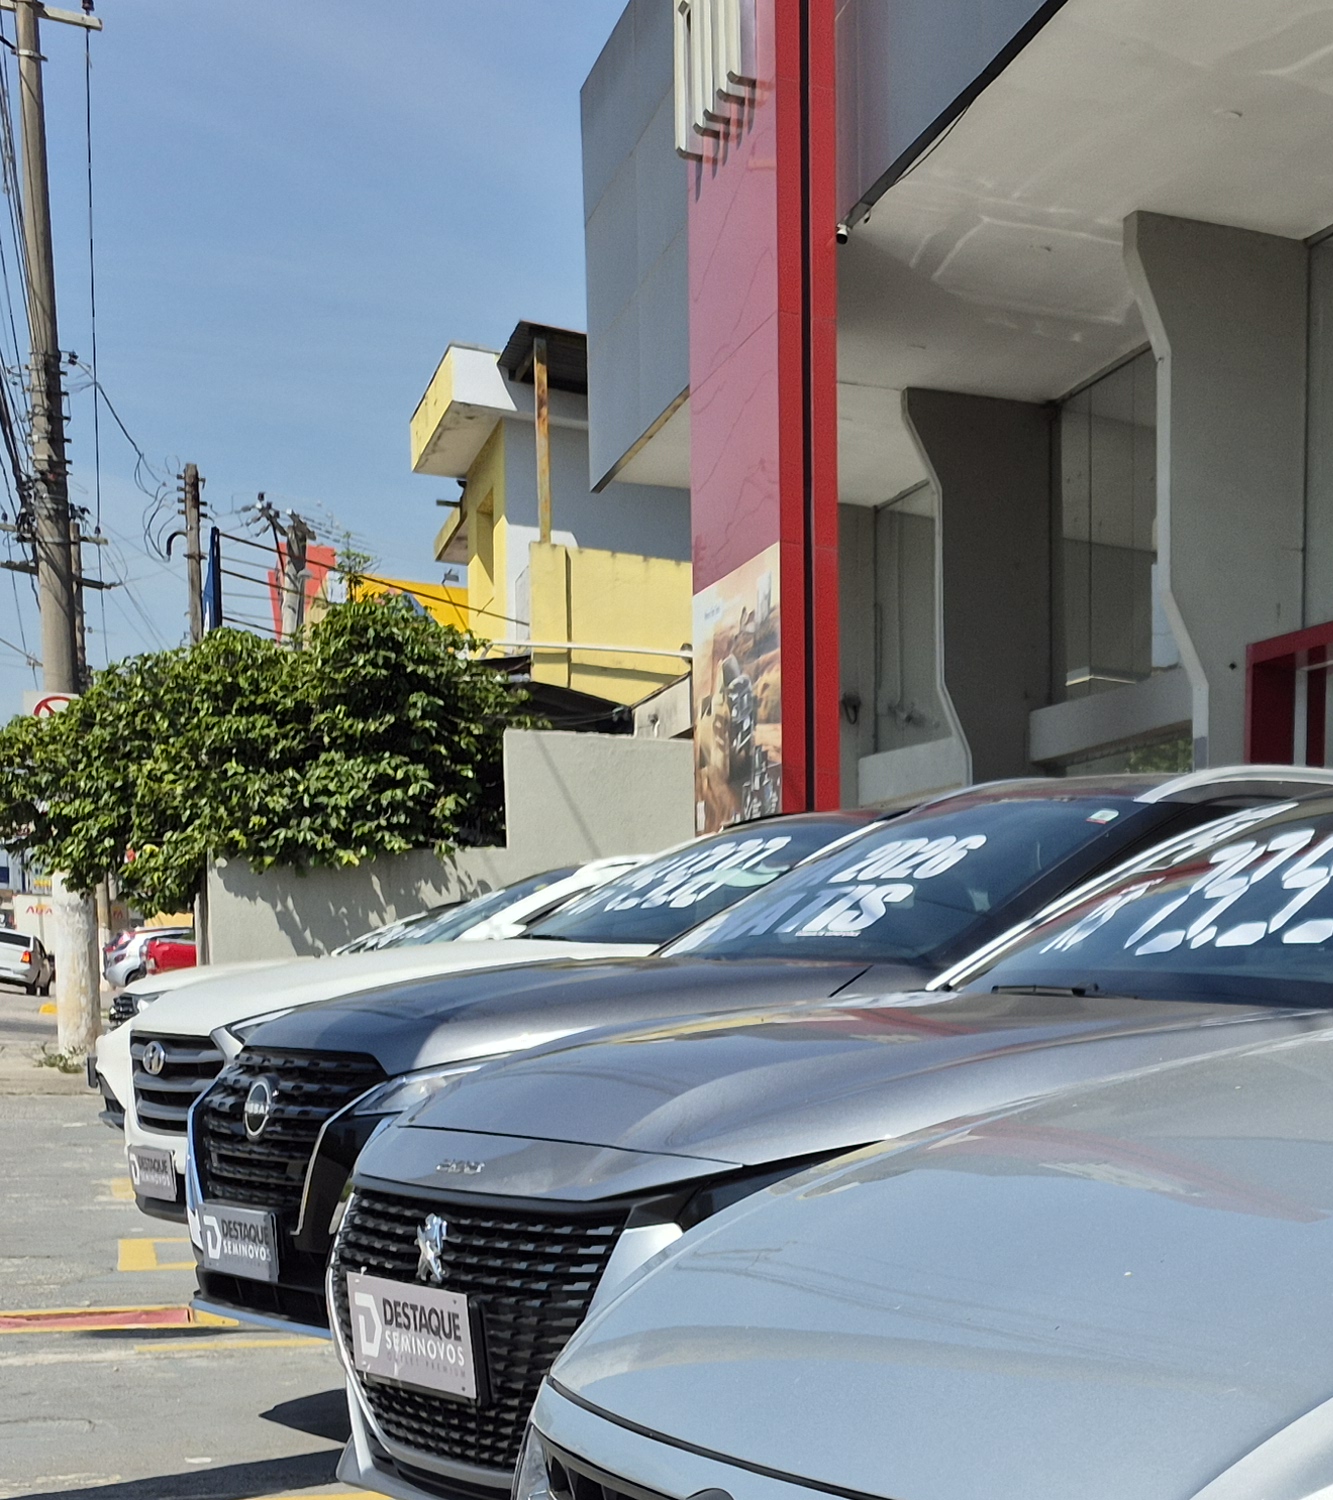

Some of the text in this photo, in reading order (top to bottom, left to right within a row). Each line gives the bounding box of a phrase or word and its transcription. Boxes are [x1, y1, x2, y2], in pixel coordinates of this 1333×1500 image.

[827, 834, 987, 884] 2026
[221, 1218, 269, 1246] DESTAQUE
[223, 1239, 271, 1261] SEMINOVOS
[383, 1297, 462, 1342] DESTAQUE
[385, 1330, 464, 1367] SEMINOVOS
